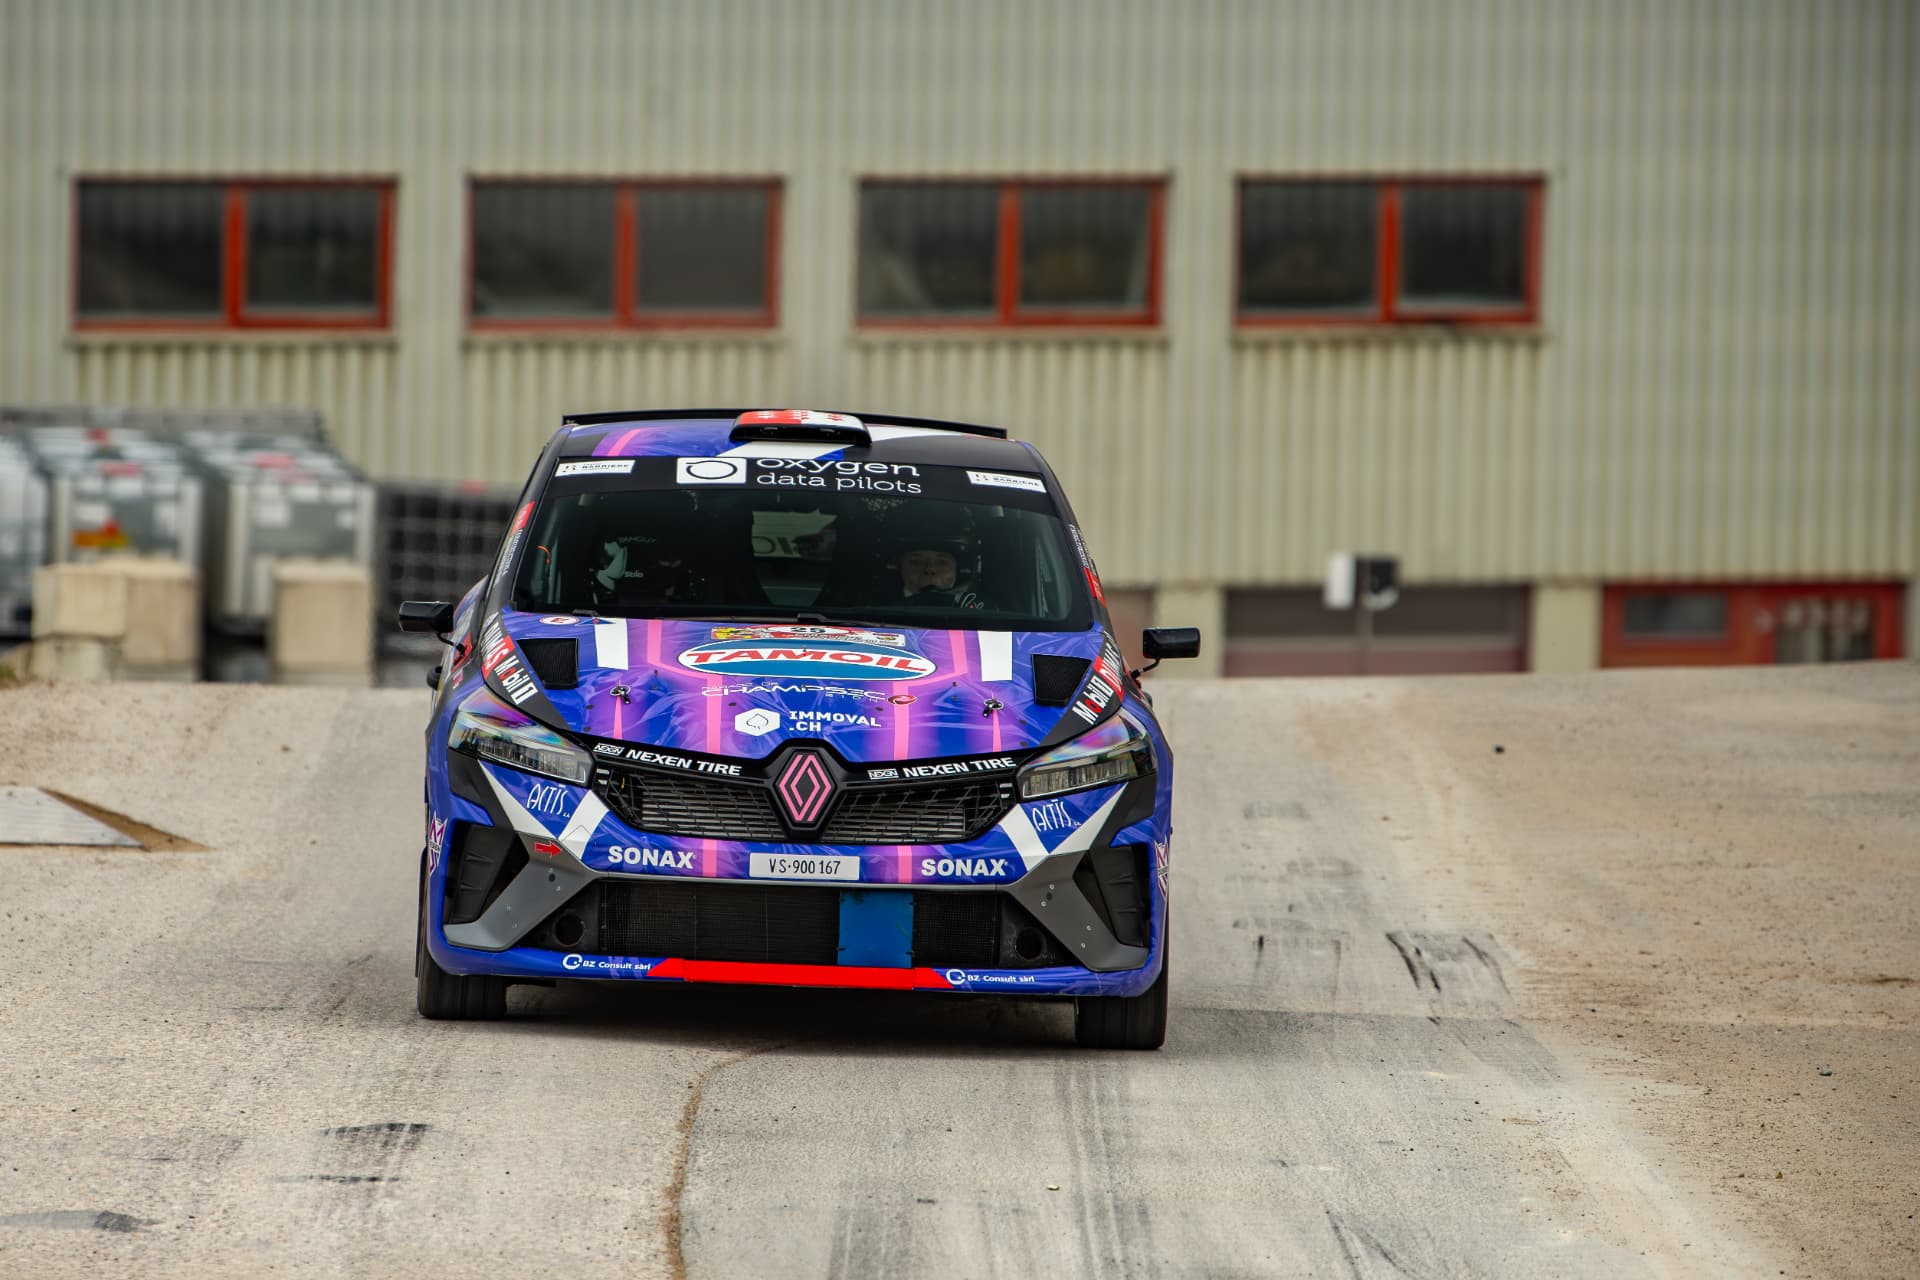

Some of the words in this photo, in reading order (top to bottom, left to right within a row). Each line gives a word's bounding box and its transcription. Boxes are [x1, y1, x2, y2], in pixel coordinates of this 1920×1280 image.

[756, 458, 920, 477] oxygen
[756, 472, 826, 487] data
[835, 477, 922, 494] pilots
[687, 649, 927, 672] TAMOIL
[494, 655, 530, 692] Mobil
[1072, 682, 1109, 725] Mobil
[789, 711, 882, 728] IMMOVAL
[789, 721, 822, 732] .CH
[626, 749, 692, 769] NEXEN
[696, 760, 742, 776] TIRE
[902, 762, 970, 778] NEXEN
[971, 757, 1017, 770] TIRE
[526, 783, 569, 816] ACTIS
[1032, 799, 1072, 832] ACTIS
[608, 845, 694, 869] SONAX
[921, 858, 1006, 876] SONAX
[582, 960, 596, 968] BZ
[598, 961, 632, 970] Consult
[967, 974, 980, 982] BZ
[983, 975, 1017, 983] Consult
